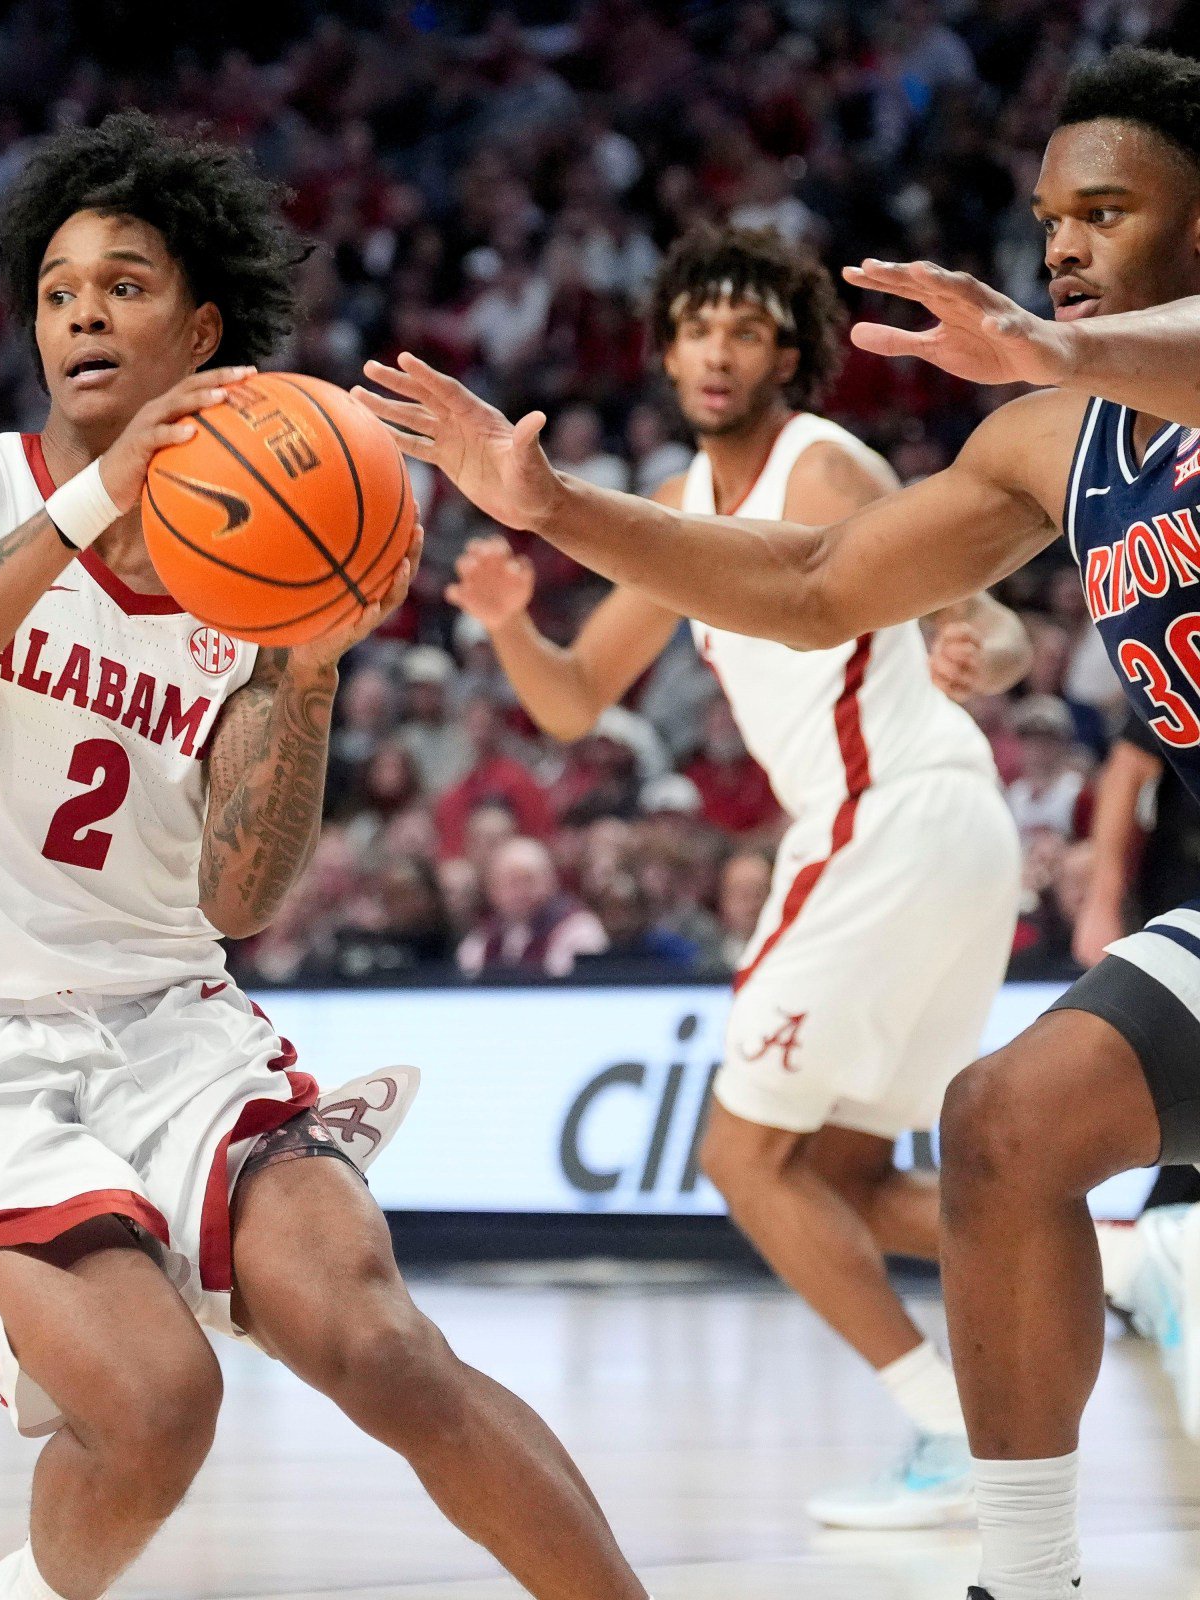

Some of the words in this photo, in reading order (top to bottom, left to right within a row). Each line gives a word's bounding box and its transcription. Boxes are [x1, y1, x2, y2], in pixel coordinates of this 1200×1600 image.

[189, 627, 236, 675] SEC
[41, 738, 131, 872] 2
[559, 1014, 722, 1193] ci
